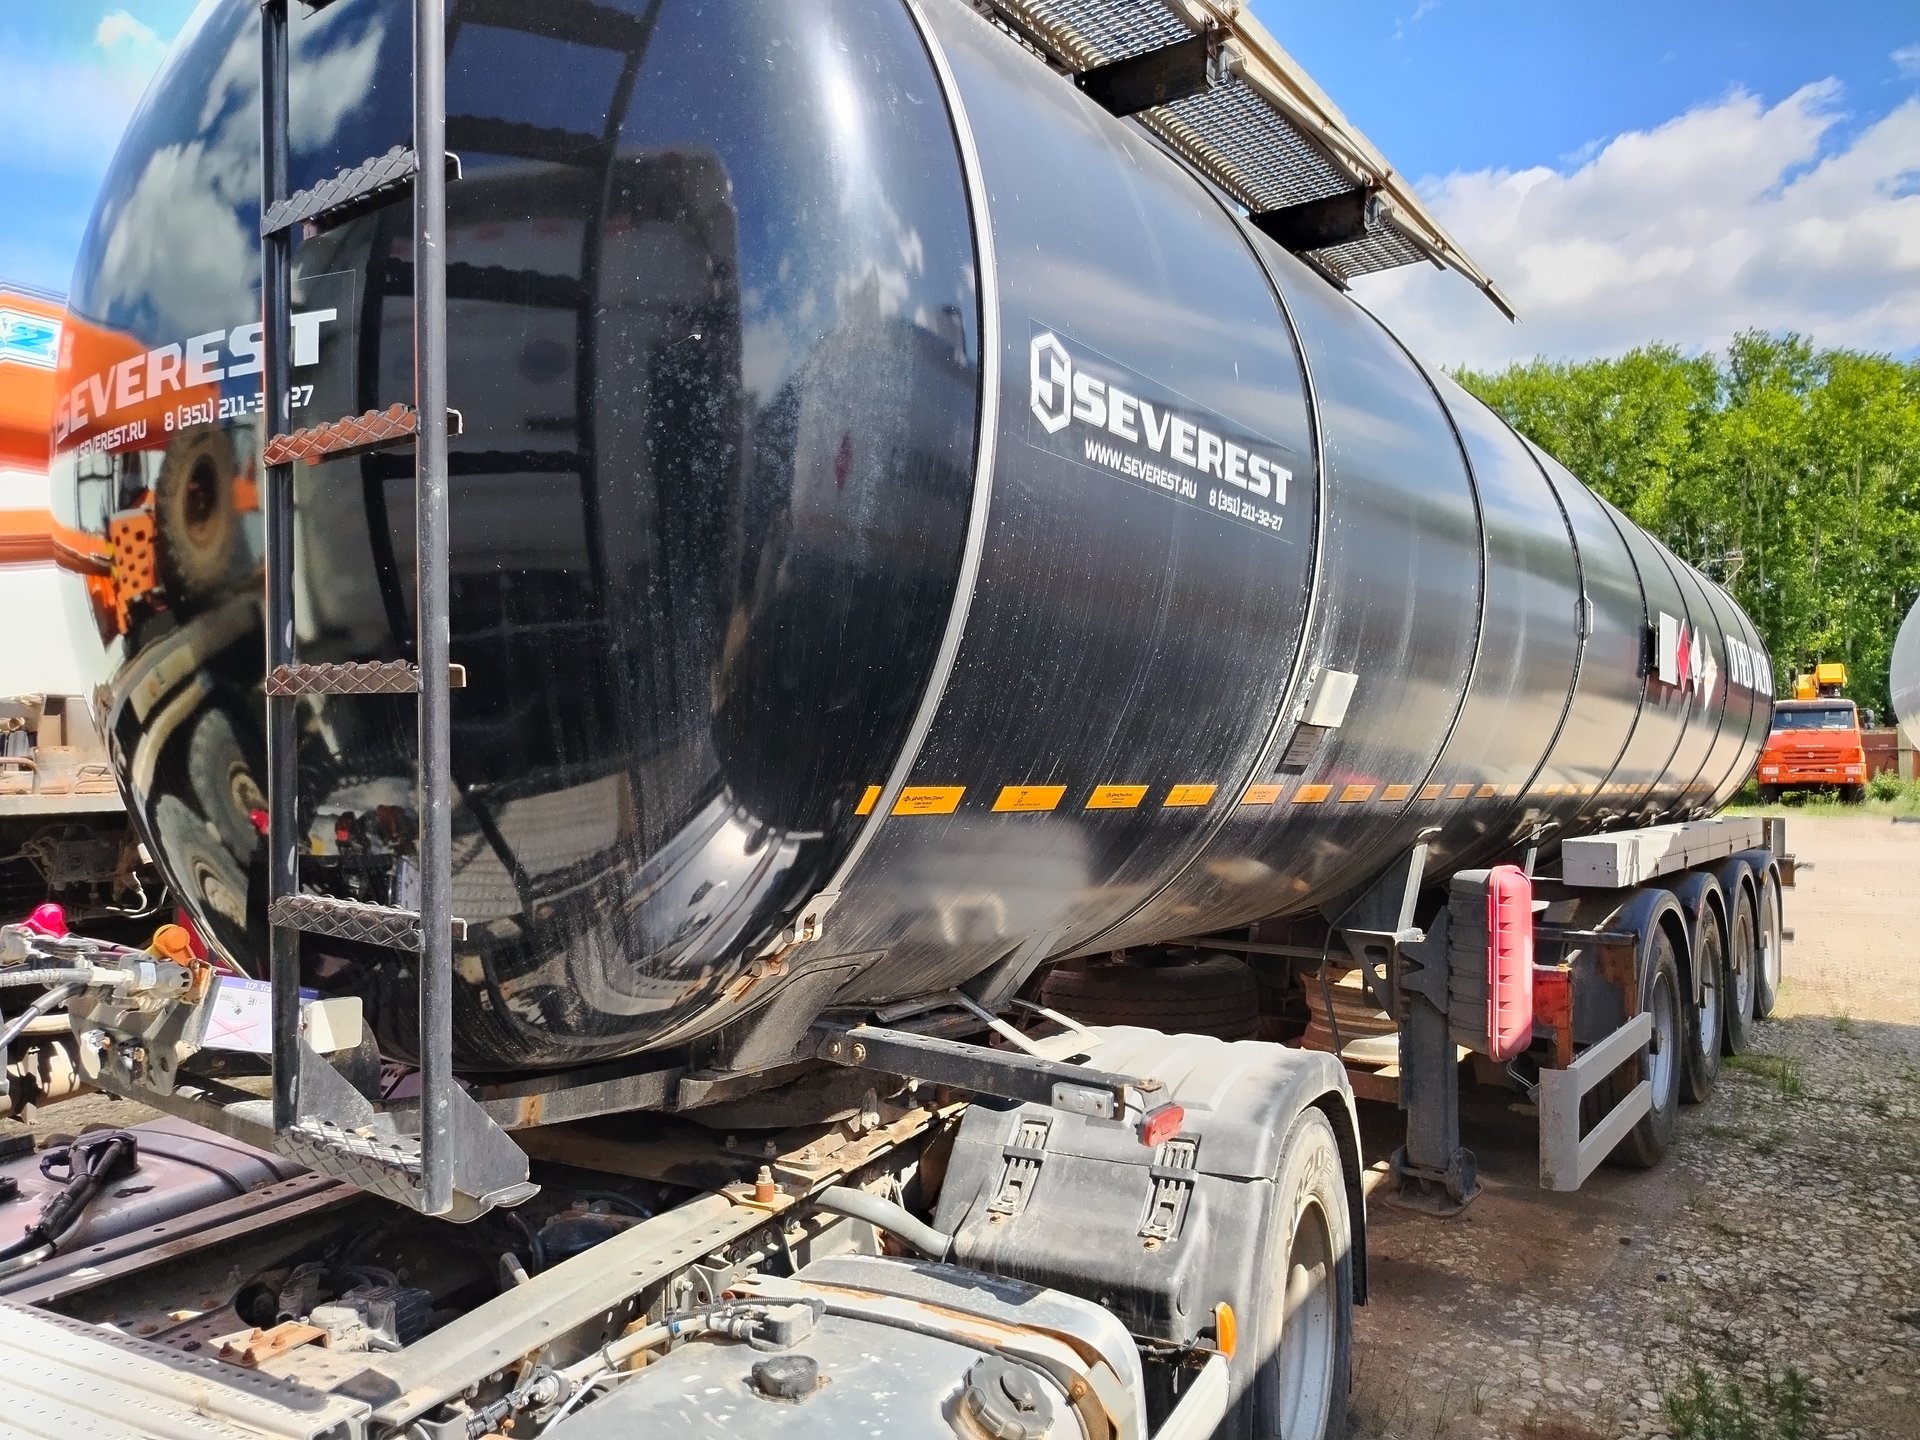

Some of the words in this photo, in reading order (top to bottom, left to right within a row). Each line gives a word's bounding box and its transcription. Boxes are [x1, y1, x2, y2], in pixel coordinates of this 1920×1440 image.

[56, 308, 337, 444] SEVEREST
[68, 418, 147, 464] .SEVEREST.RU
[164, 411, 174, 432] 8
[177, 397, 214, 430] (351)
[218, 384, 314, 419] 211-327
[1073, 370, 1292, 506] SEVEREST
[1084, 437, 1197, 499] WWW.SEVEREST.RU
[1208, 488, 1217, 507] 8
[1217, 488, 1240, 517] (351)
[1241, 501, 1284, 531] 211-32-27
